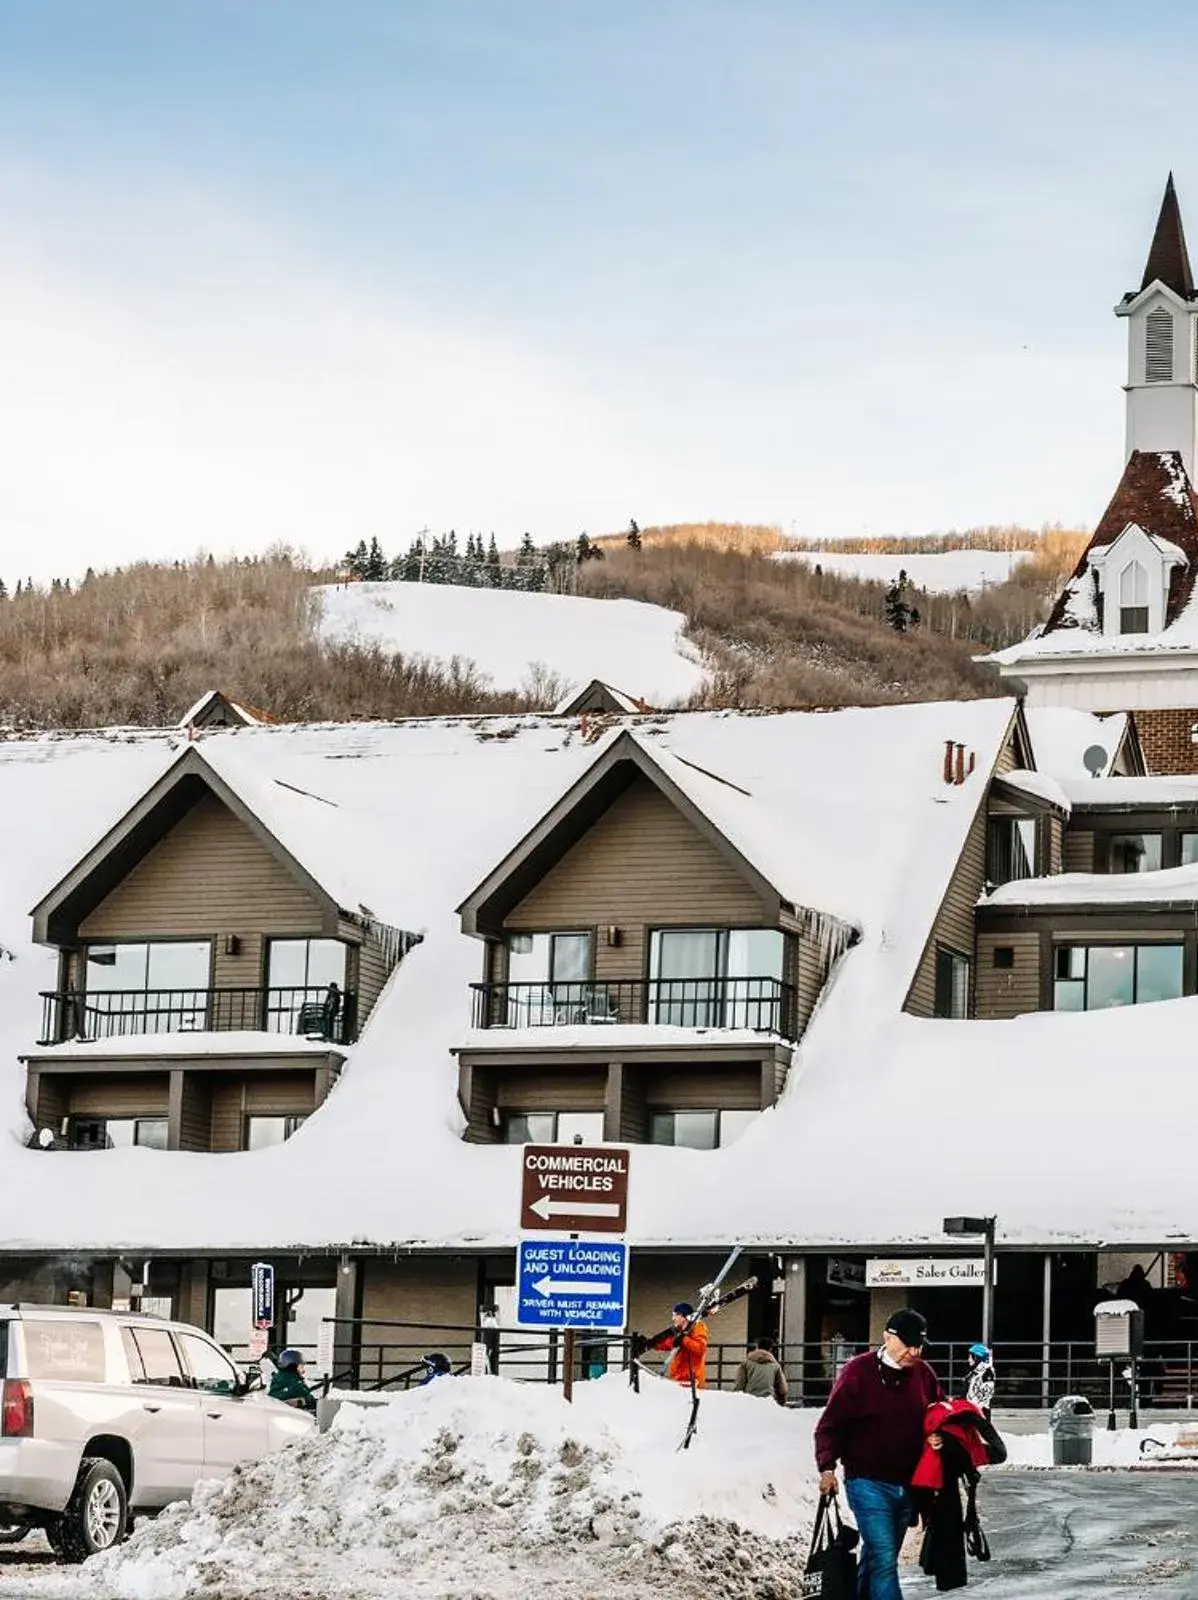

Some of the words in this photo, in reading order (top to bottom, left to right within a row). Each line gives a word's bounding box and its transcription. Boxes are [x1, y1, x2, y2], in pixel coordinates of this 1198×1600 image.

[525, 1155, 627, 1173] COMMERCIAL
[538, 1174, 613, 1192] VEHICLES
[524, 1249, 565, 1260] GUEST
[568, 1249, 621, 1262] LOADING
[523, 1262, 549, 1273] AND
[552, 1263, 621, 1276] UNLOADING
[916, 1264, 946, 1278] Sales
[949, 1264, 985, 1278] Galler
[557, 1300, 582, 1309] MUST
[539, 1308, 561, 1317] WITH
[564, 1309, 603, 1319] VEHICLE
